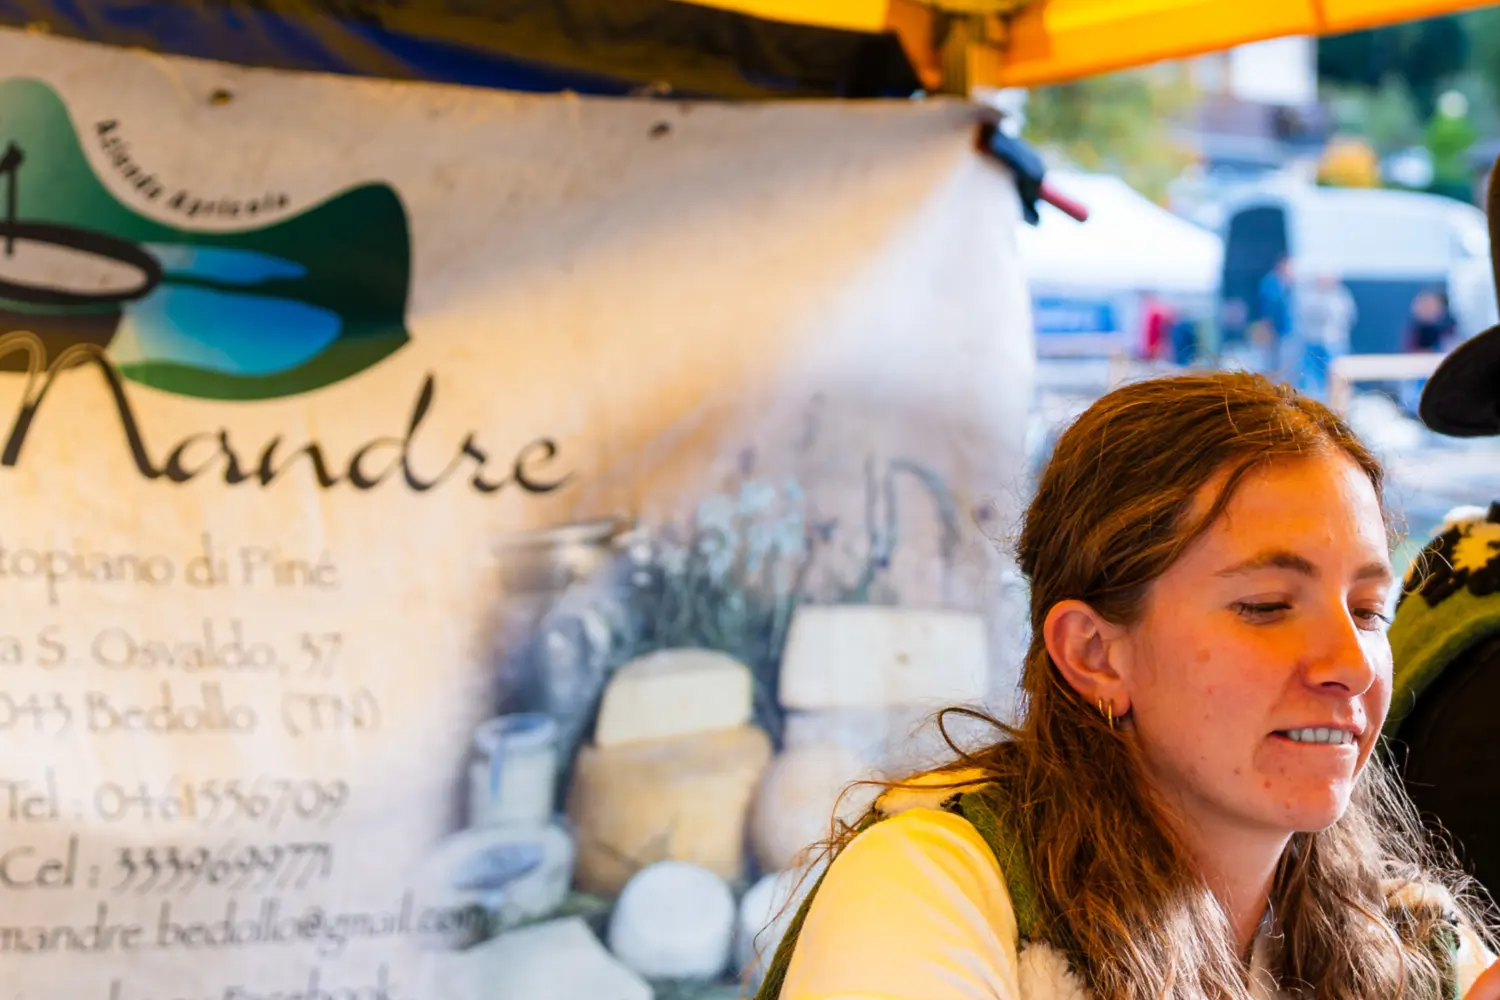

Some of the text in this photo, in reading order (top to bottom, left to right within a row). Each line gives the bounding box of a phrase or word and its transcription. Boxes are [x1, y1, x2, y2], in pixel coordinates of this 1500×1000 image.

[94, 118, 291, 219] Azienda Agricola
[184, 531, 229, 587] di
[85, 680, 259, 736] Bedollo
[280, 685, 382, 738] (TN)
[93, 772, 351, 829] 0461556709
